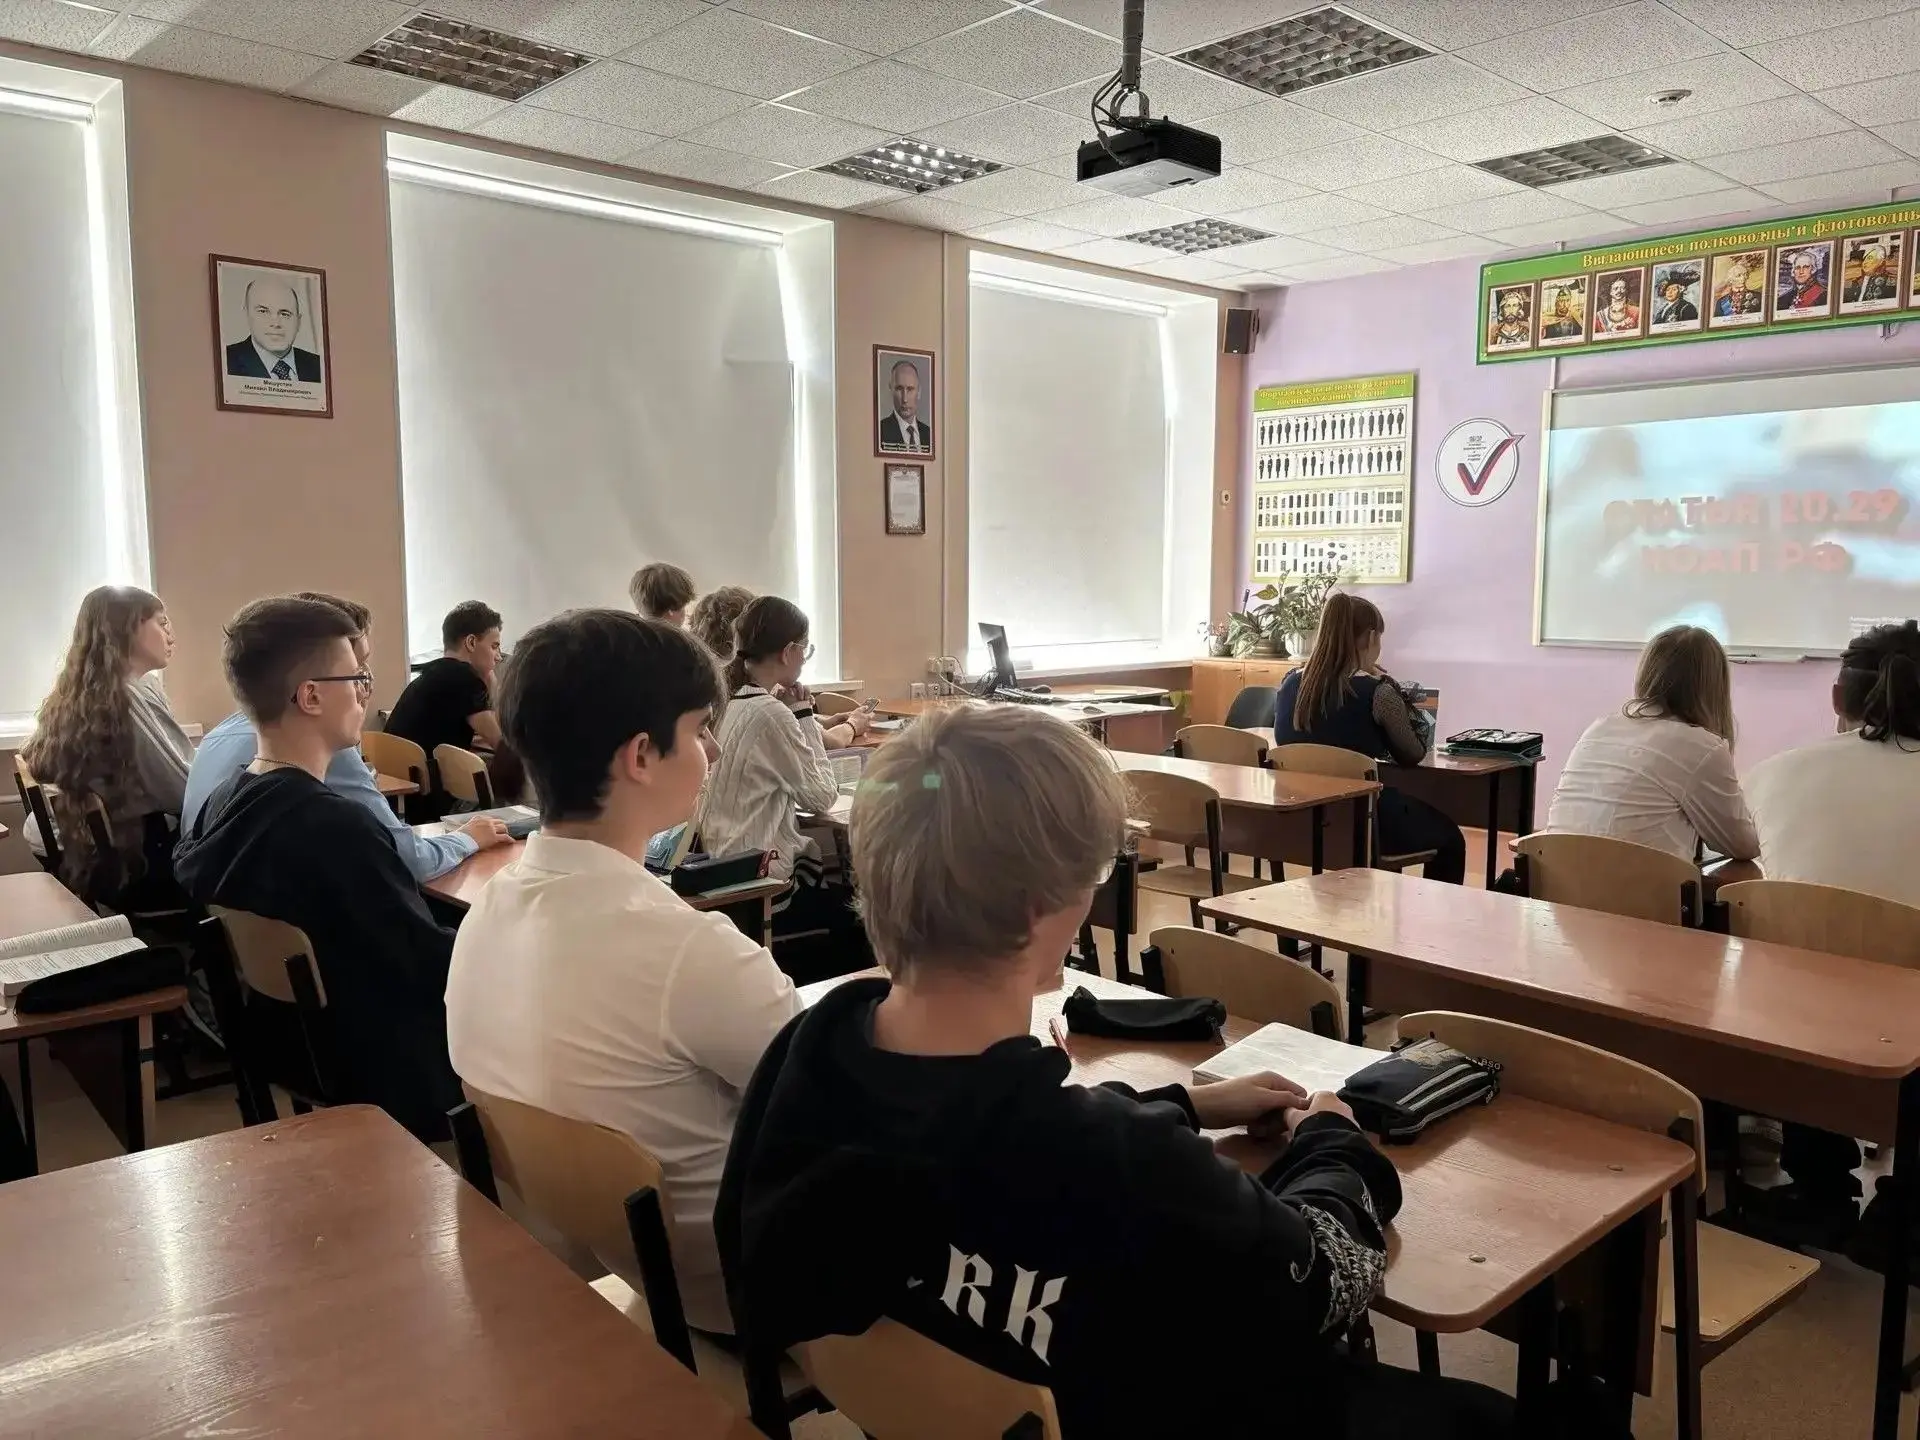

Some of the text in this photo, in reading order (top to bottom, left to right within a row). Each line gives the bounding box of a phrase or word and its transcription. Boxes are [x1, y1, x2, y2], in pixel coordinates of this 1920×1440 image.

[1583, 243, 1684, 268] Выдающиеся
[1689, 228, 1790, 251] полководцы
[1797, 224, 1807, 237] и
[1603, 491, 1761, 527] СТАТЬЯ
[1781, 540, 1849, 574] РФ
[906, 1243, 1068, 1367] RK
